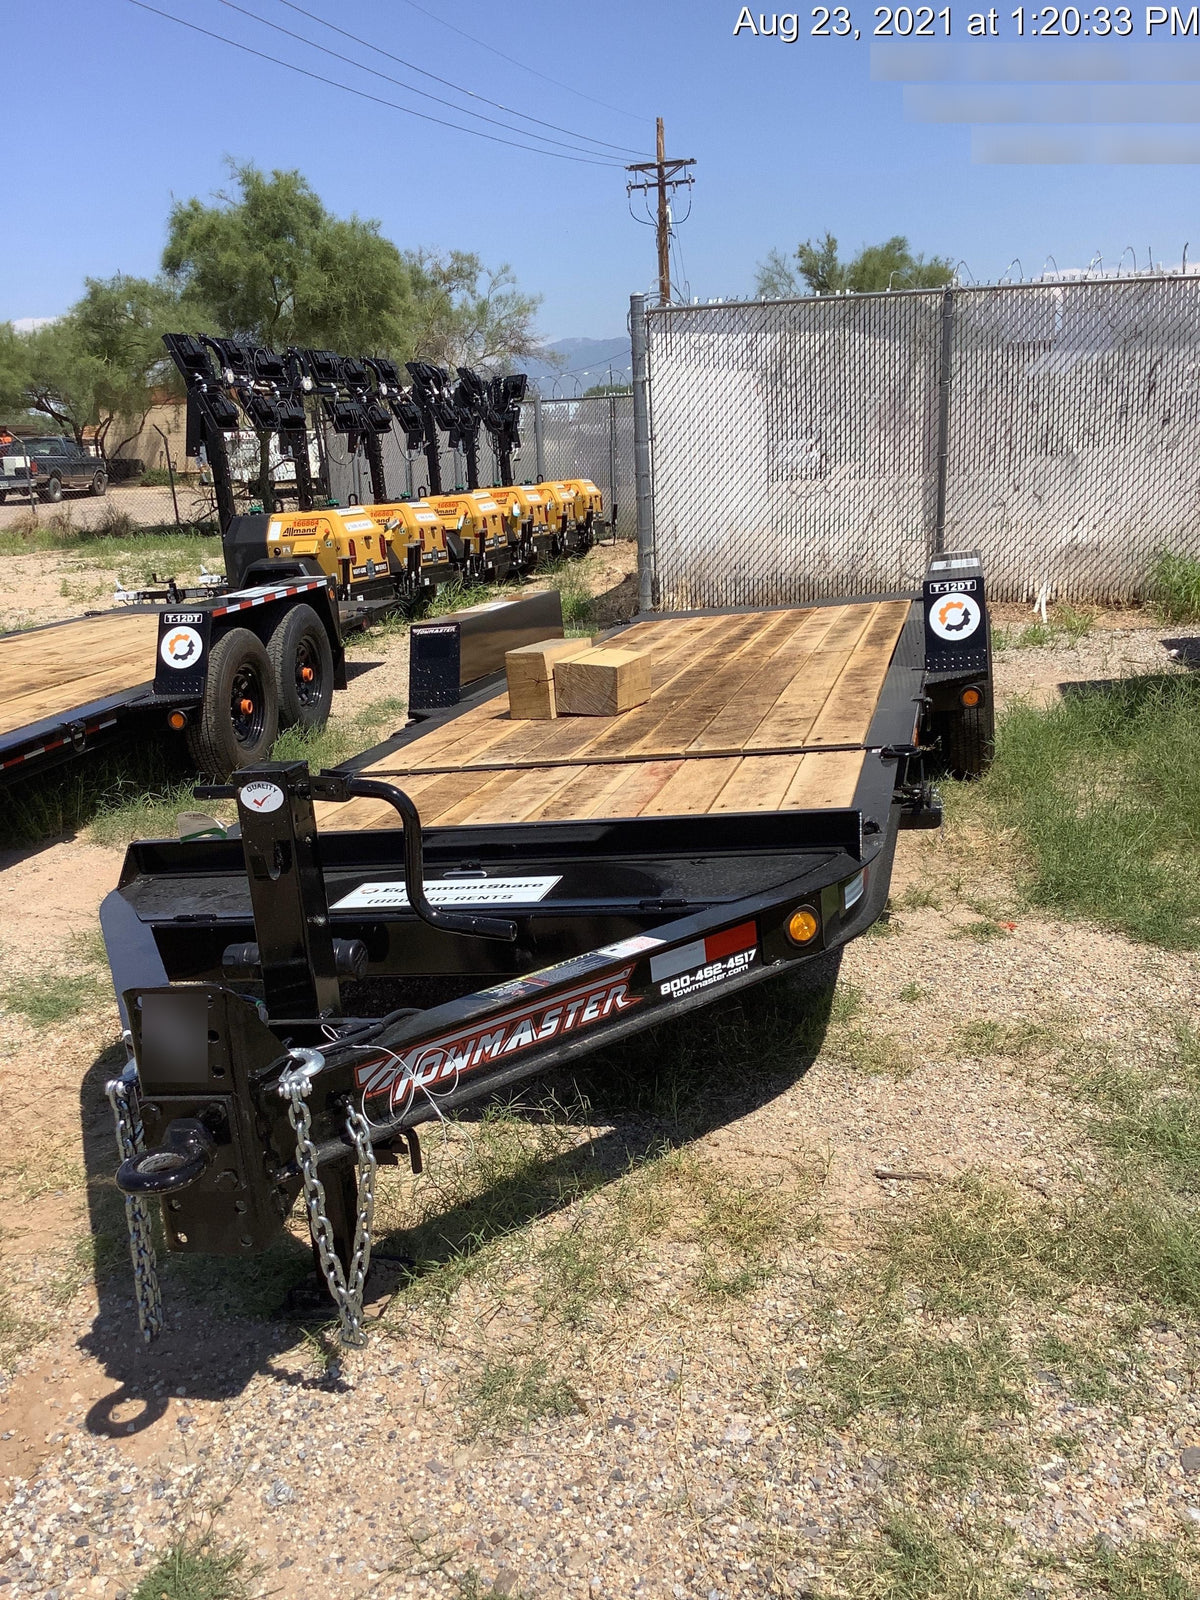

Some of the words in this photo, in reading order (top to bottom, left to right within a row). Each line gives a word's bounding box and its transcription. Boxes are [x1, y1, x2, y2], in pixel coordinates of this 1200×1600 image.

[282, 527, 317, 537] Allmand
[933, 582, 973, 592] T-12DT
[167, 615, 200, 623] T-12DT
[246, 783, 278, 793] QUALITY
[383, 882, 544, 893] EqpmentShare
[660, 948, 757, 996] 800-462-4517
[672, 963, 749, 998] towmaster.com
[355, 967, 632, 1103] TOWMASTER
